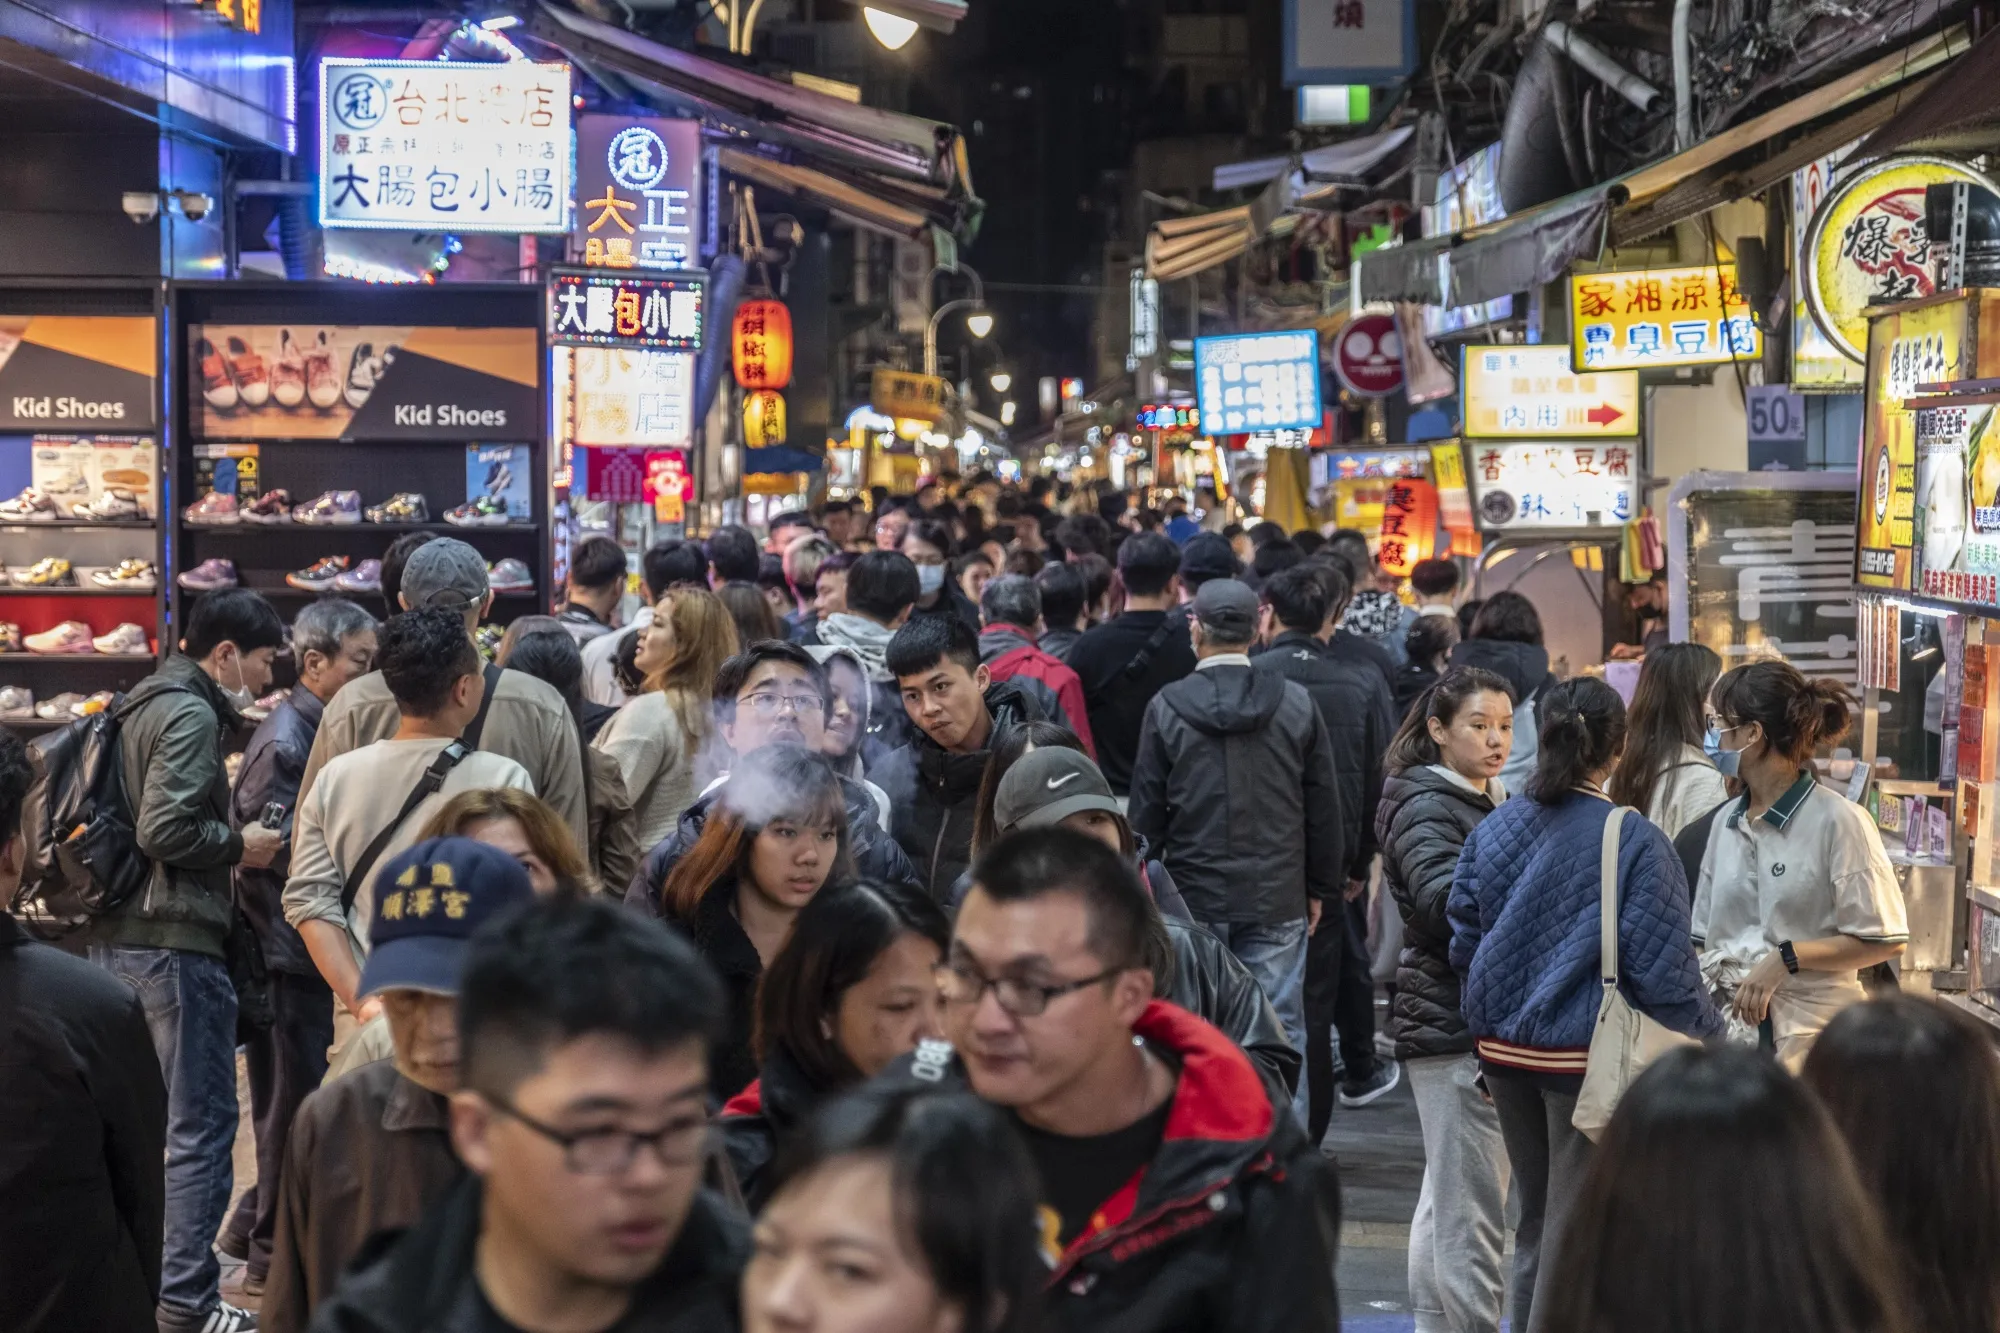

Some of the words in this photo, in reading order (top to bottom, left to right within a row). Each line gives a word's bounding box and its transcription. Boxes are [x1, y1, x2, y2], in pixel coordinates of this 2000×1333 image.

[343, 81, 378, 120] 冠
[332, 163, 554, 212] 大腸包小腸
[13, 396, 51, 418] Kid
[55, 396, 125, 419] Shoes
[394, 404, 432, 426] Kid
[437, 404, 506, 426] Shoes
[1478, 447, 1632, 481] 香豆腐
